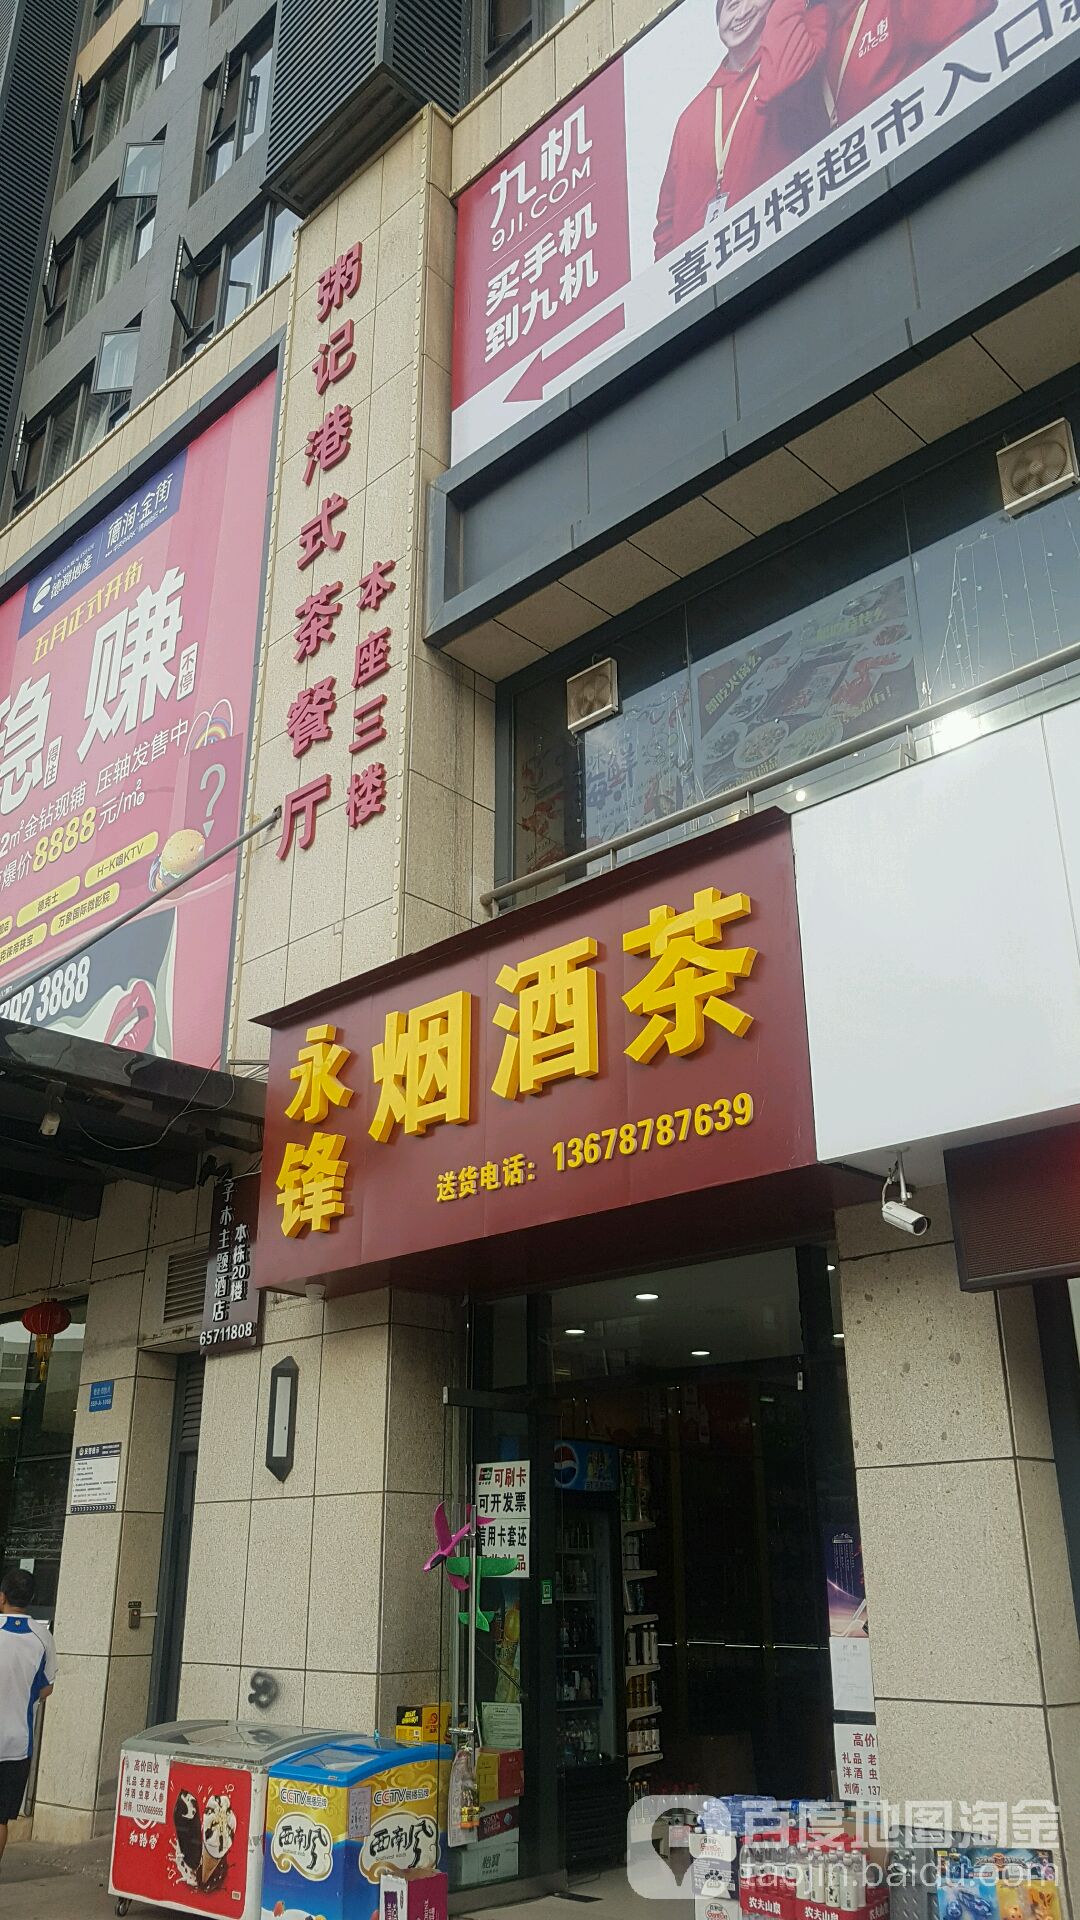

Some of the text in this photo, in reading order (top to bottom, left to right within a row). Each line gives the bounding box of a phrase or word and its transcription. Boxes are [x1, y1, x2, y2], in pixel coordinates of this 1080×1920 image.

[490, 105, 592, 228] 九机
[493, 157, 591, 252] 9JI.COM
[486, 202, 597, 317] 买手机
[485, 249, 598, 363] 到九机
[276, 241, 362, 860] 粥记港式茶餐厅
[32, 556, 143, 665] 五月正式开街
[77, 566, 185, 763] 赚
[181, 649, 195, 694] 不停
[346, 559, 396, 829] 本座三楼
[95, 719, 189, 796] 压轴发售中
[36, 955, 90, 1022] 3888
[368, 886, 758, 1143] 烟酒茶
[275, 1023, 354, 1239] 永锋
[436, 1092, 754, 1203] 送货电话： 13678787639
[230, 1223, 248, 1302] 本栋20楼
[200, 1321, 253, 1346] 65711808
[478, 1491, 527, 1513] 可开发票
[494, 1467, 527, 1488] 可刷卡
[133, 1759, 160, 1774] 高价回收
[842, 1751, 877, 1766] 礼品 老
[843, 1766, 864, 1779] 洋酒
[852, 1732, 879, 1748] 高价
[278, 1824, 329, 1870] 西南风
[369, 1819, 435, 1869] 西南风
[748, 1897, 781, 1915] 农夫山泉
